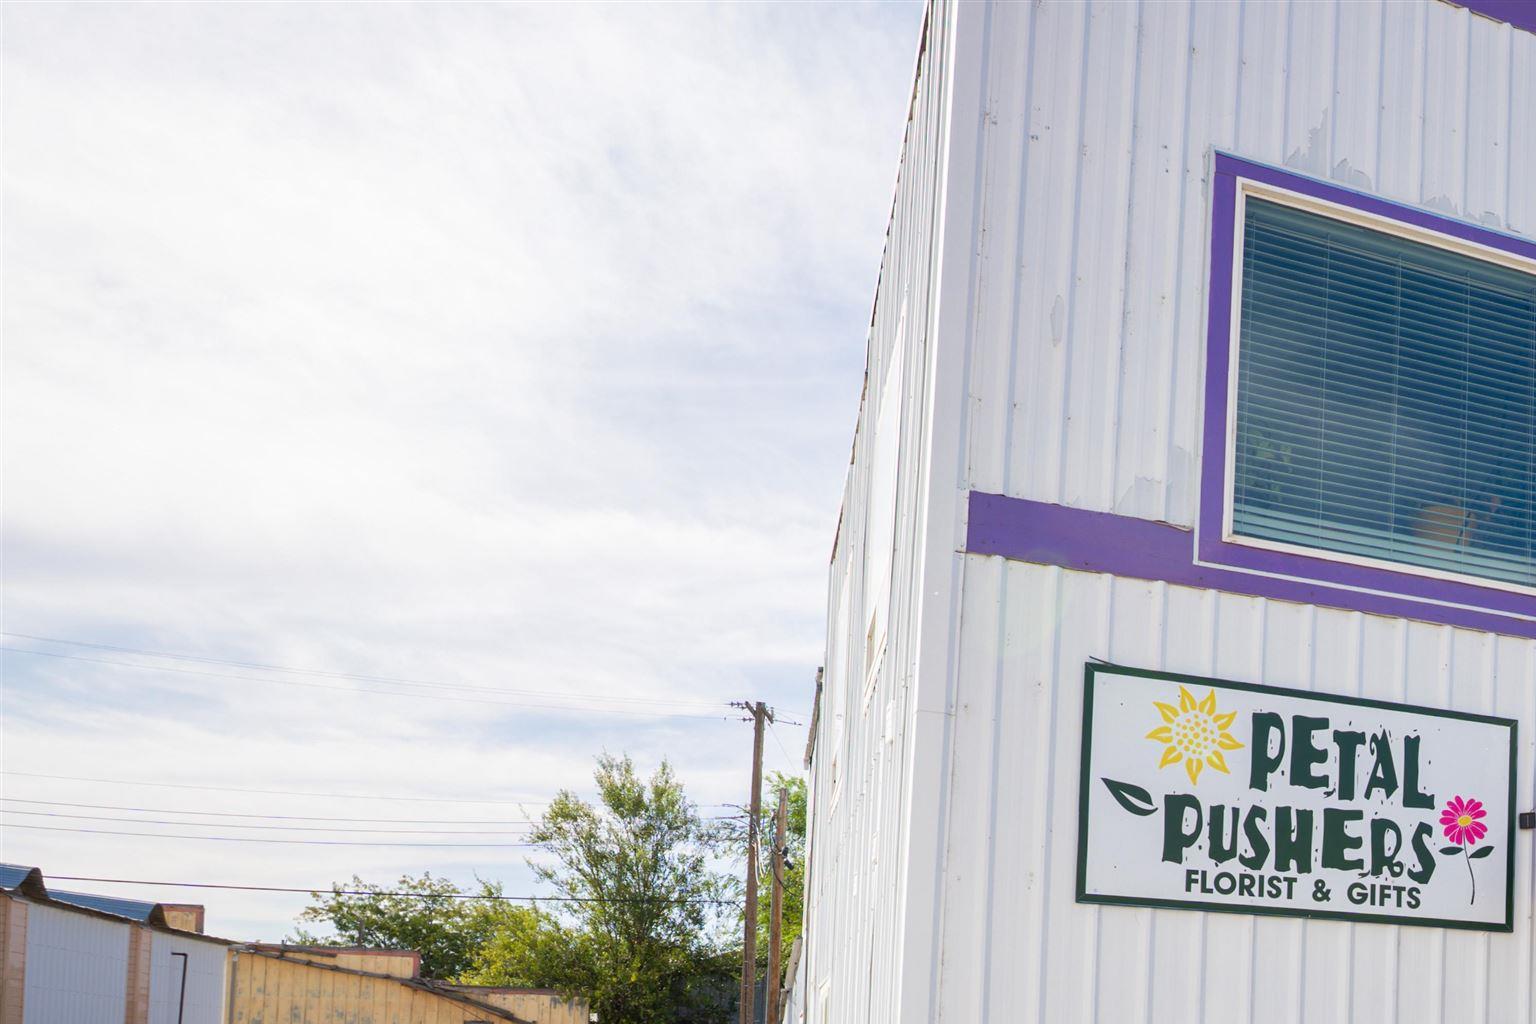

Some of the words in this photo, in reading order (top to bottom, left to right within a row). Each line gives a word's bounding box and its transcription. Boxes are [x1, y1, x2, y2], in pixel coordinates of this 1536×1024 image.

[1249, 711, 1436, 810] PETAL
[1162, 793, 1436, 885] PUSHERS
[1185, 869, 1297, 900] FLORIST
[1312, 879, 1332, 903] &
[1346, 881, 1422, 909] GIFTS
